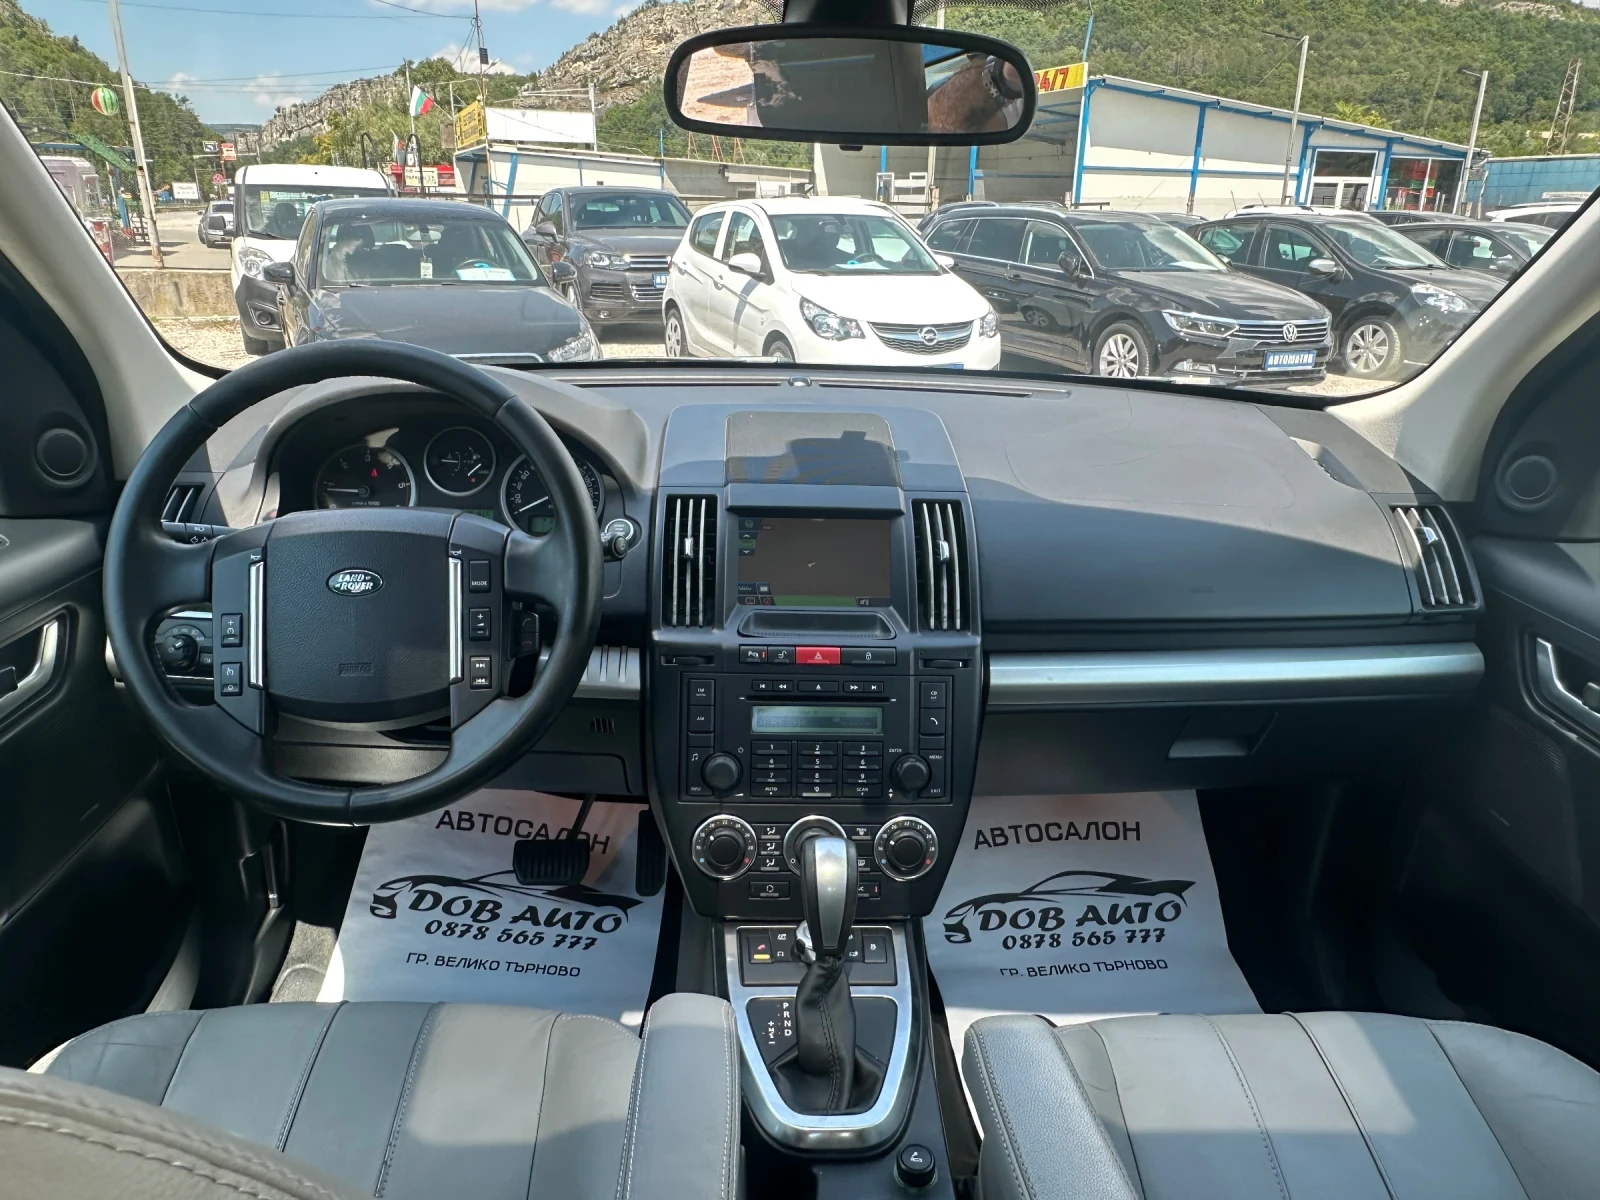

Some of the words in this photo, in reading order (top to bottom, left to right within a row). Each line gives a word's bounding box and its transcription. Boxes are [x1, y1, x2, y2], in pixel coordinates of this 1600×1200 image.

[338, 573, 365, 582] LAND
[340, 581, 373, 591] ROVER
[435, 809, 610, 855] АВТОСАН
[974, 821, 1141, 850] АВТОСАЛОН
[408, 888, 503, 923] DOB
[510, 905, 623, 934] AUTO
[977, 906, 1066, 932] DOB
[1075, 900, 1183, 927] AUTO
[424, 919, 490, 941] 0878
[497, 928, 545, 946] 565
[552, 933, 599, 951] 777
[1002, 933, 1062, 951] 0878
[1071, 930, 1116, 948] 565
[1126, 927, 1167, 944] 777
[406, 952, 430, 966] ГР.
[434, 955, 500, 972] ВЕЛИКО
[505, 961, 581, 978] ТЪРНОВО
[999, 967, 1024, 977] ГР.
[1027, 962, 1091, 978] ВЕЛИКО
[1093, 959, 1169, 973] ТЪРНОВО
[783, 1001, 789, 1009] P
[783, 1010, 790, 1018] R
[784, 1019, 791, 1027] N
